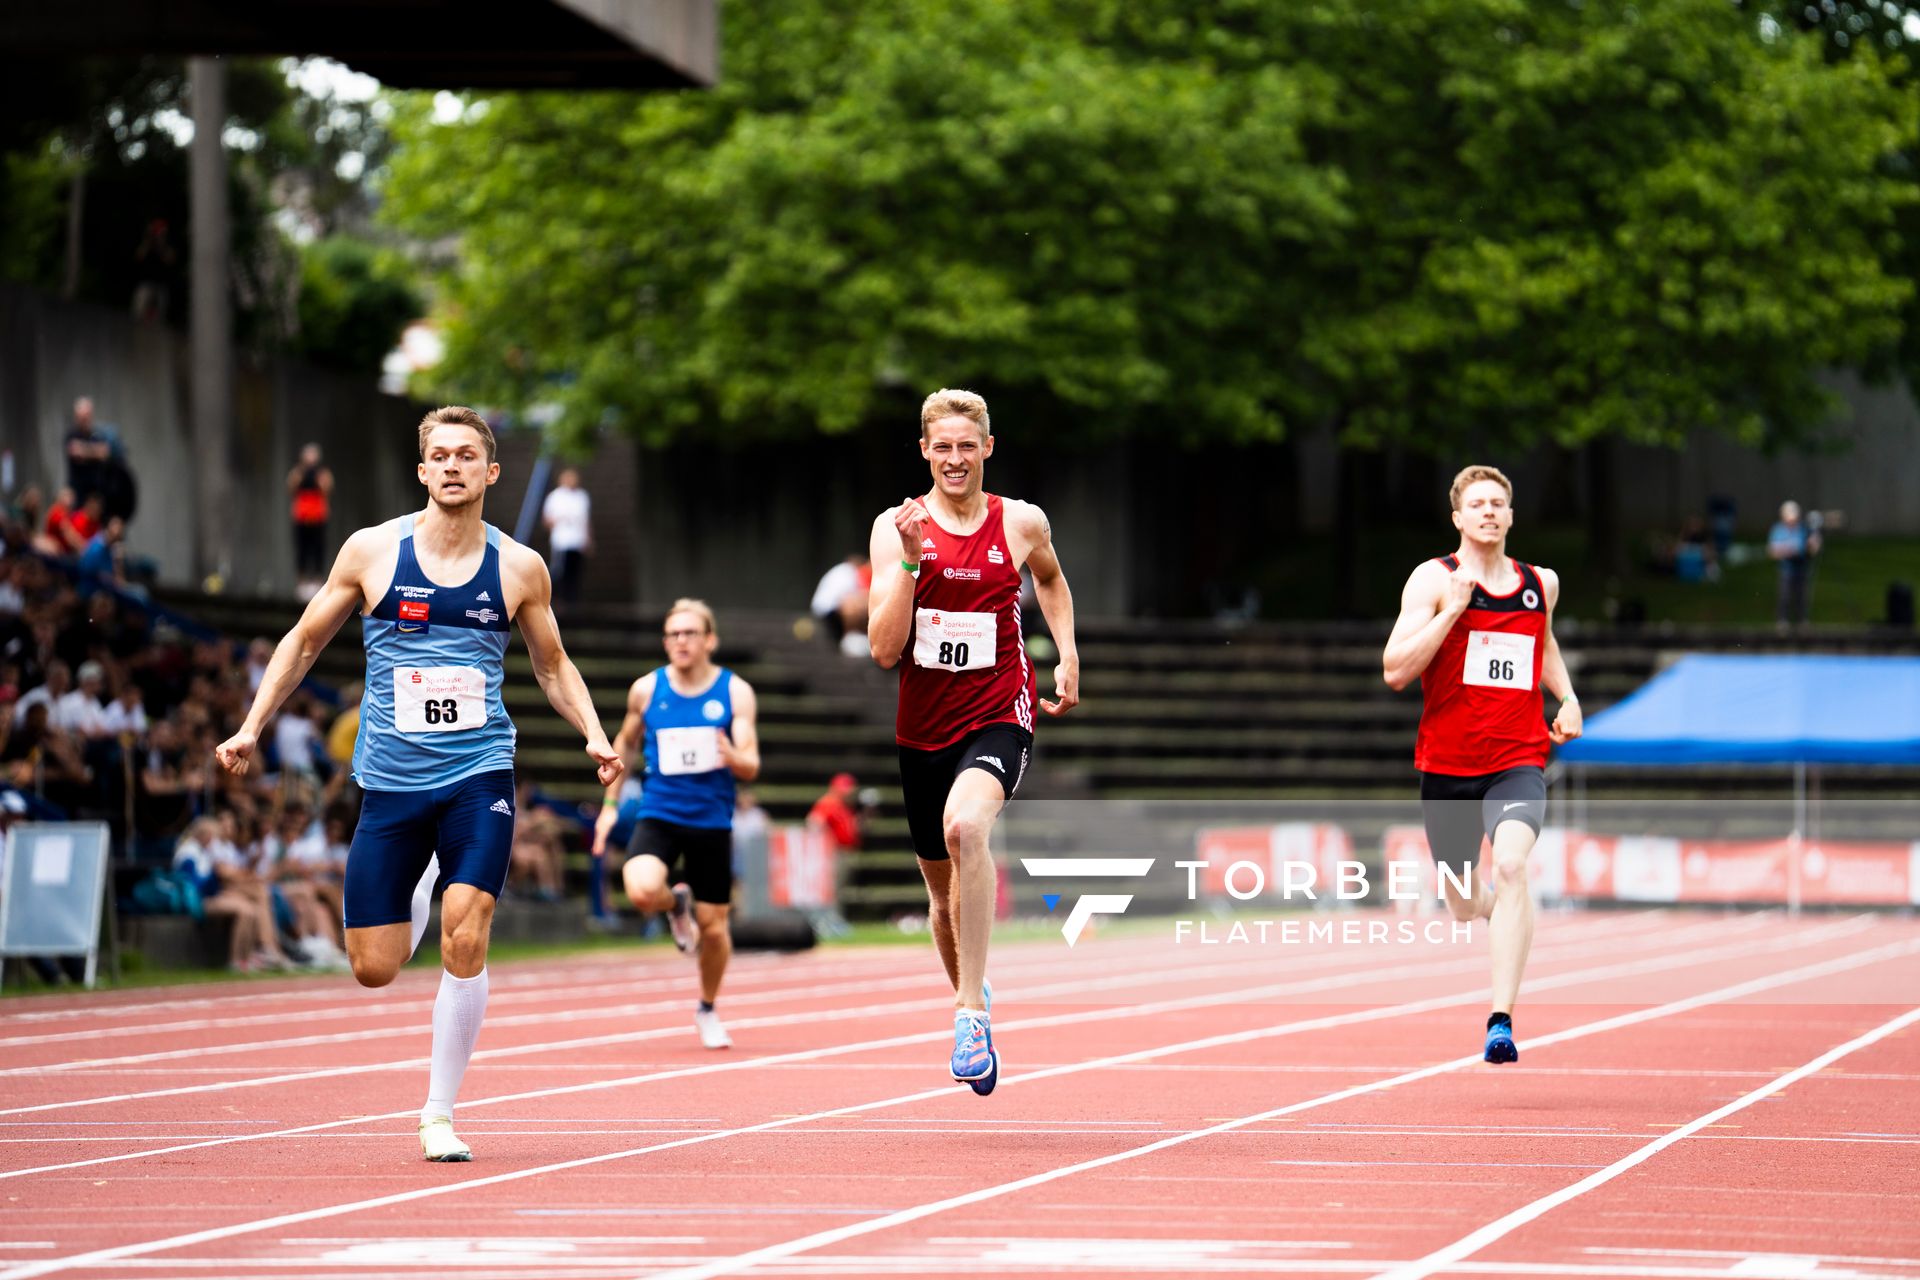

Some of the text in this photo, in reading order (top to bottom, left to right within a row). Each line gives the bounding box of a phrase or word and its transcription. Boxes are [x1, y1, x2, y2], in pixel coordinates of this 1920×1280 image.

[944, 620, 976, 628] Sparkasse
[944, 629, 983, 639] Regensburg
[938, 641, 969, 667] 80
[1488, 659, 1514, 681] 86
[426, 676, 462, 685] Sparkasse
[426, 685, 469, 694] Regensburg
[425, 699, 458, 725] 63
[490, 805, 512, 817] adidas
